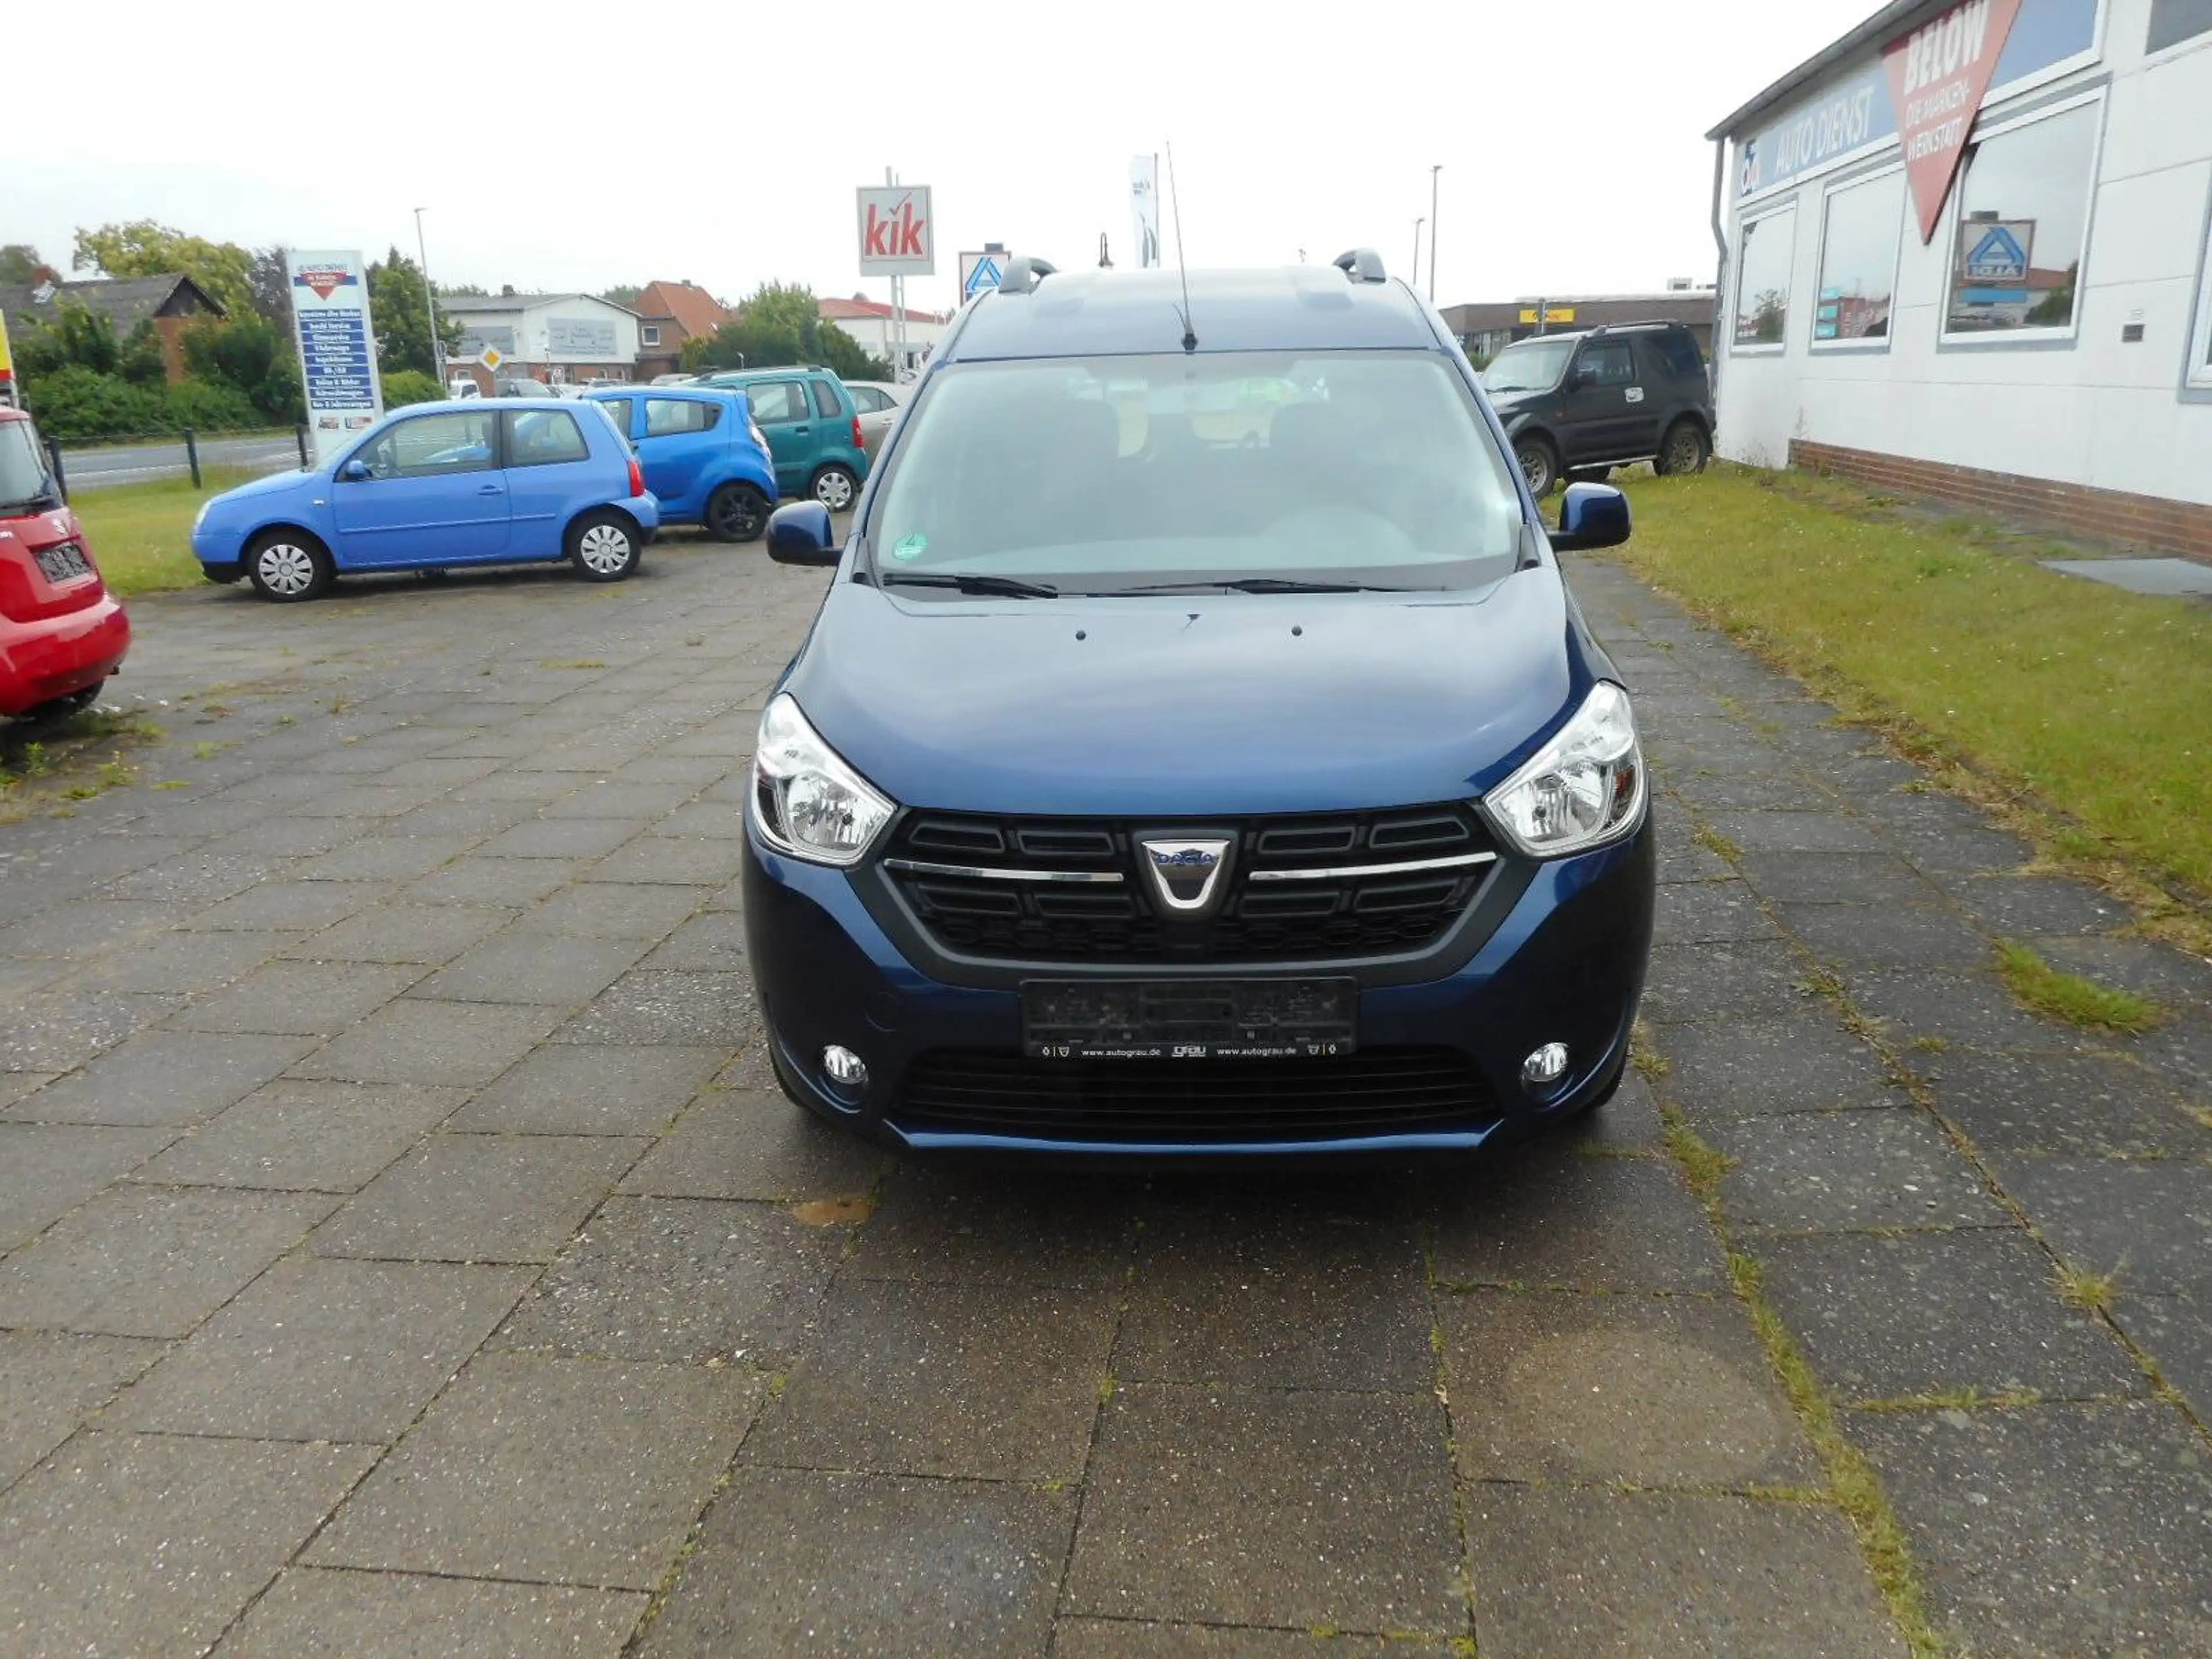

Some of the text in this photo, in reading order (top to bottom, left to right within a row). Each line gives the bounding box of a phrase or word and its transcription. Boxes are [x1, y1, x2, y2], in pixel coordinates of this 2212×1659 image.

[1904, 0, 1989, 95] BELOW
[1774, 116, 1815, 177] AUTO
[1816, 85, 1875, 158] DIENST
[1907, 115, 1962, 163] WERKSTATT
[865, 202, 925, 255] kik
[1158, 853, 1213, 865] DACIA
[1081, 1040, 1297, 1058] www.autograu.de grau www.autograu.de
